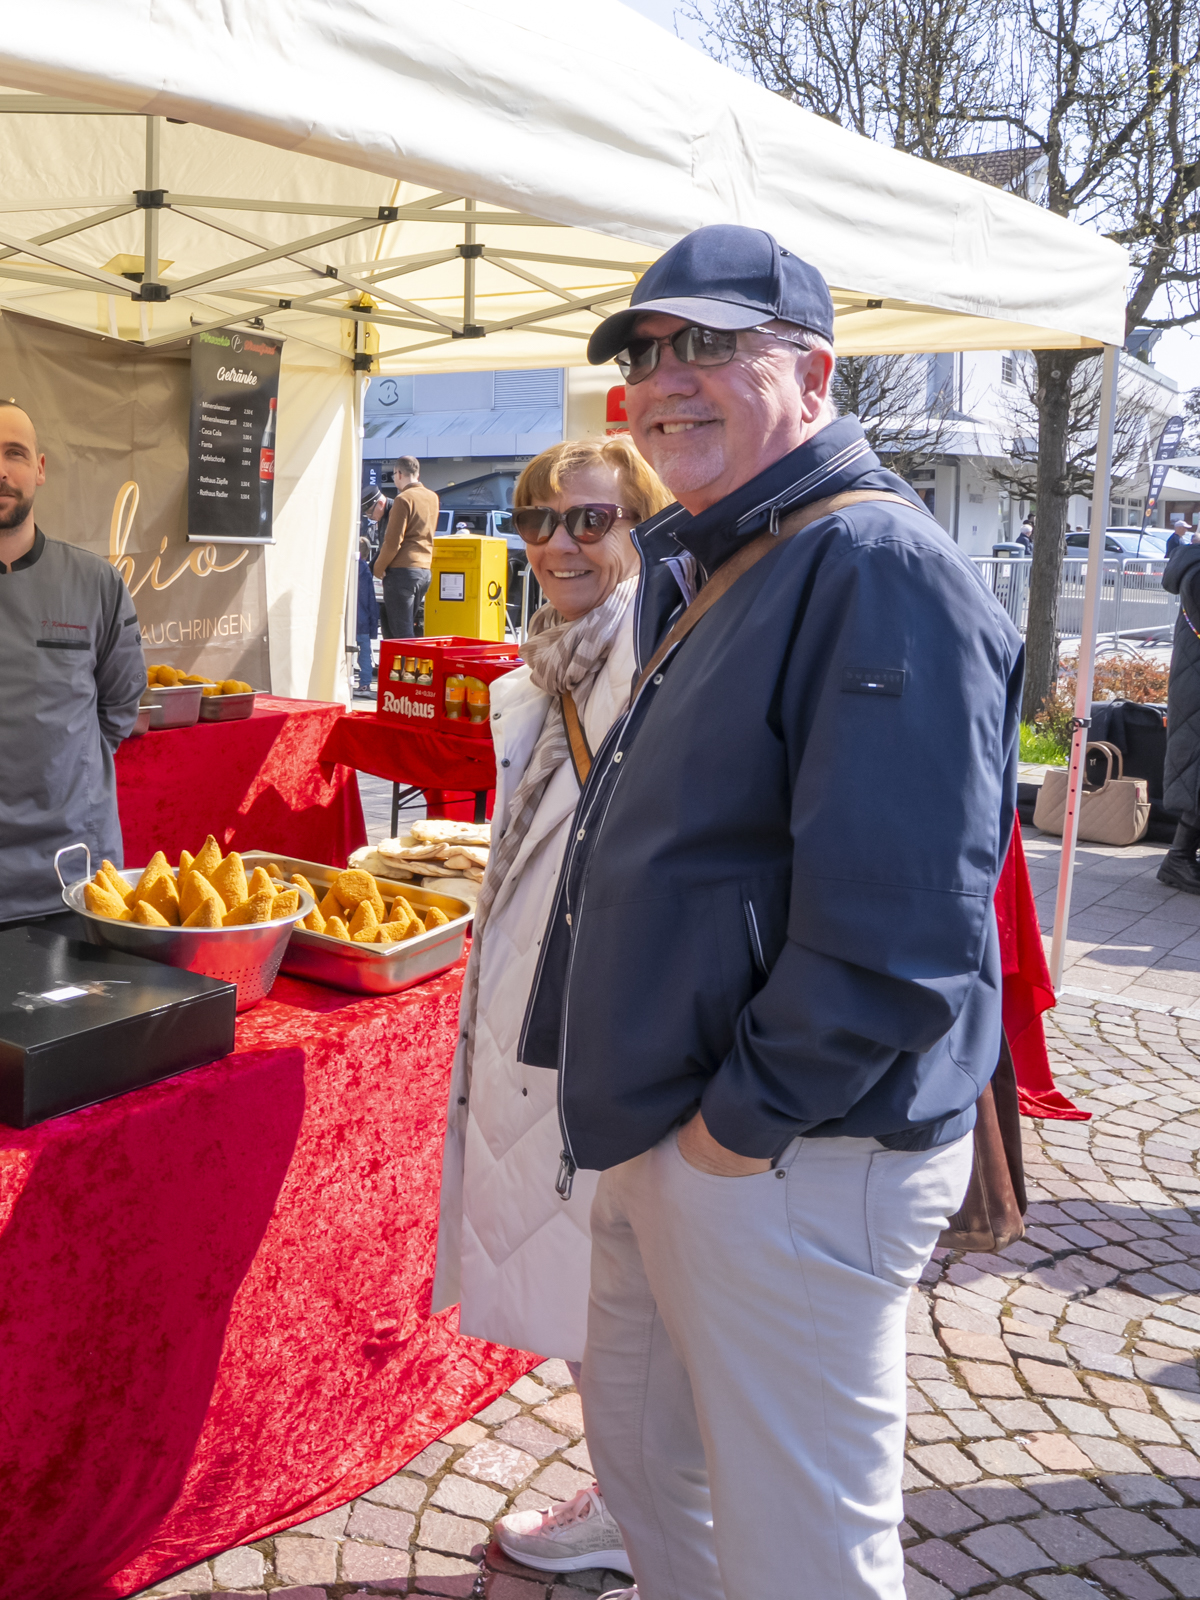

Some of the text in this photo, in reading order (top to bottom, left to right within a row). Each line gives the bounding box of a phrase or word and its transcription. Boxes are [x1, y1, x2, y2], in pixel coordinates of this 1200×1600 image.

[216, 366, 258, 386] Getränke
[201, 427, 222, 437] Coca Cola
[201, 440, 213, 449] Fanta
[200, 475, 216, 484] Rothaus
[199, 488, 216, 497] Rothaus
[108, 480, 250, 599] hio
[142, 613, 252, 645] AUCHRINGEN
[382, 691, 435, 719] Rothaus
